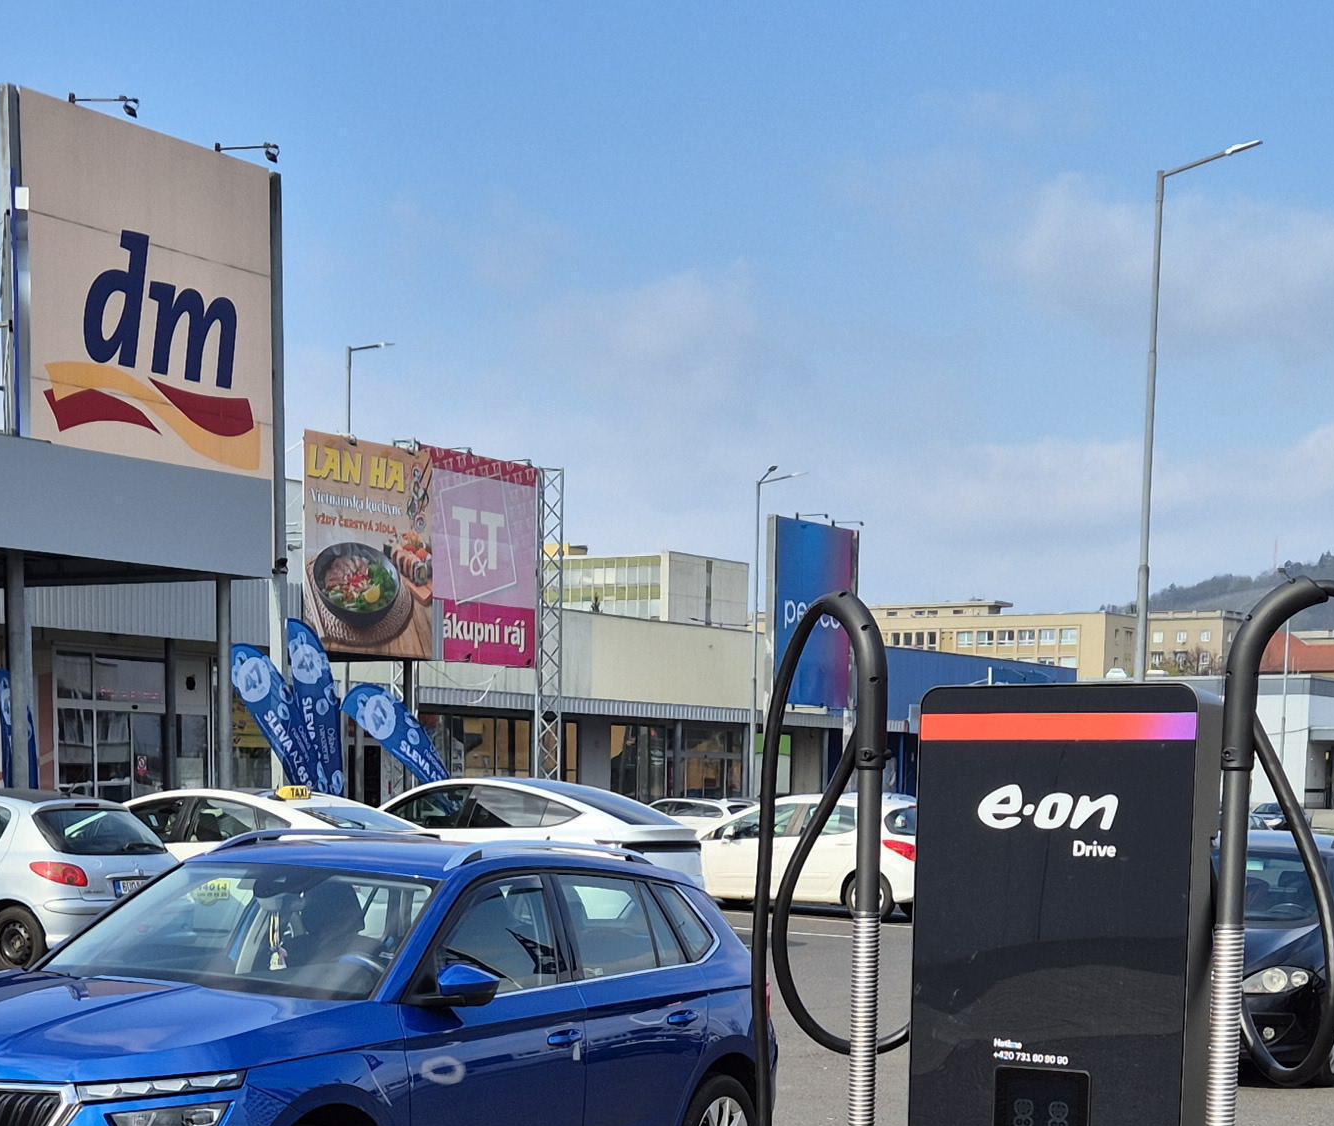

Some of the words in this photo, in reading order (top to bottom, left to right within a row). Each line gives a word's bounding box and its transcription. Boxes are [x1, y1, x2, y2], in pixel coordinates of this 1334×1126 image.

[84, 230, 237, 389] dm
[307, 444, 362, 485] LAN
[370, 457, 405, 493] HA
[452, 506, 505, 577] T&T
[443, 617, 500, 649] ákupní
[503, 618, 526, 653] ráj
[264, 710, 293, 752] SLEVA
[302, 697, 316, 740] SLEVA
[400, 740, 430, 775] SLEVA
[290, 787, 308, 798] TAXI
[1072, 840, 1117, 857] Drive
